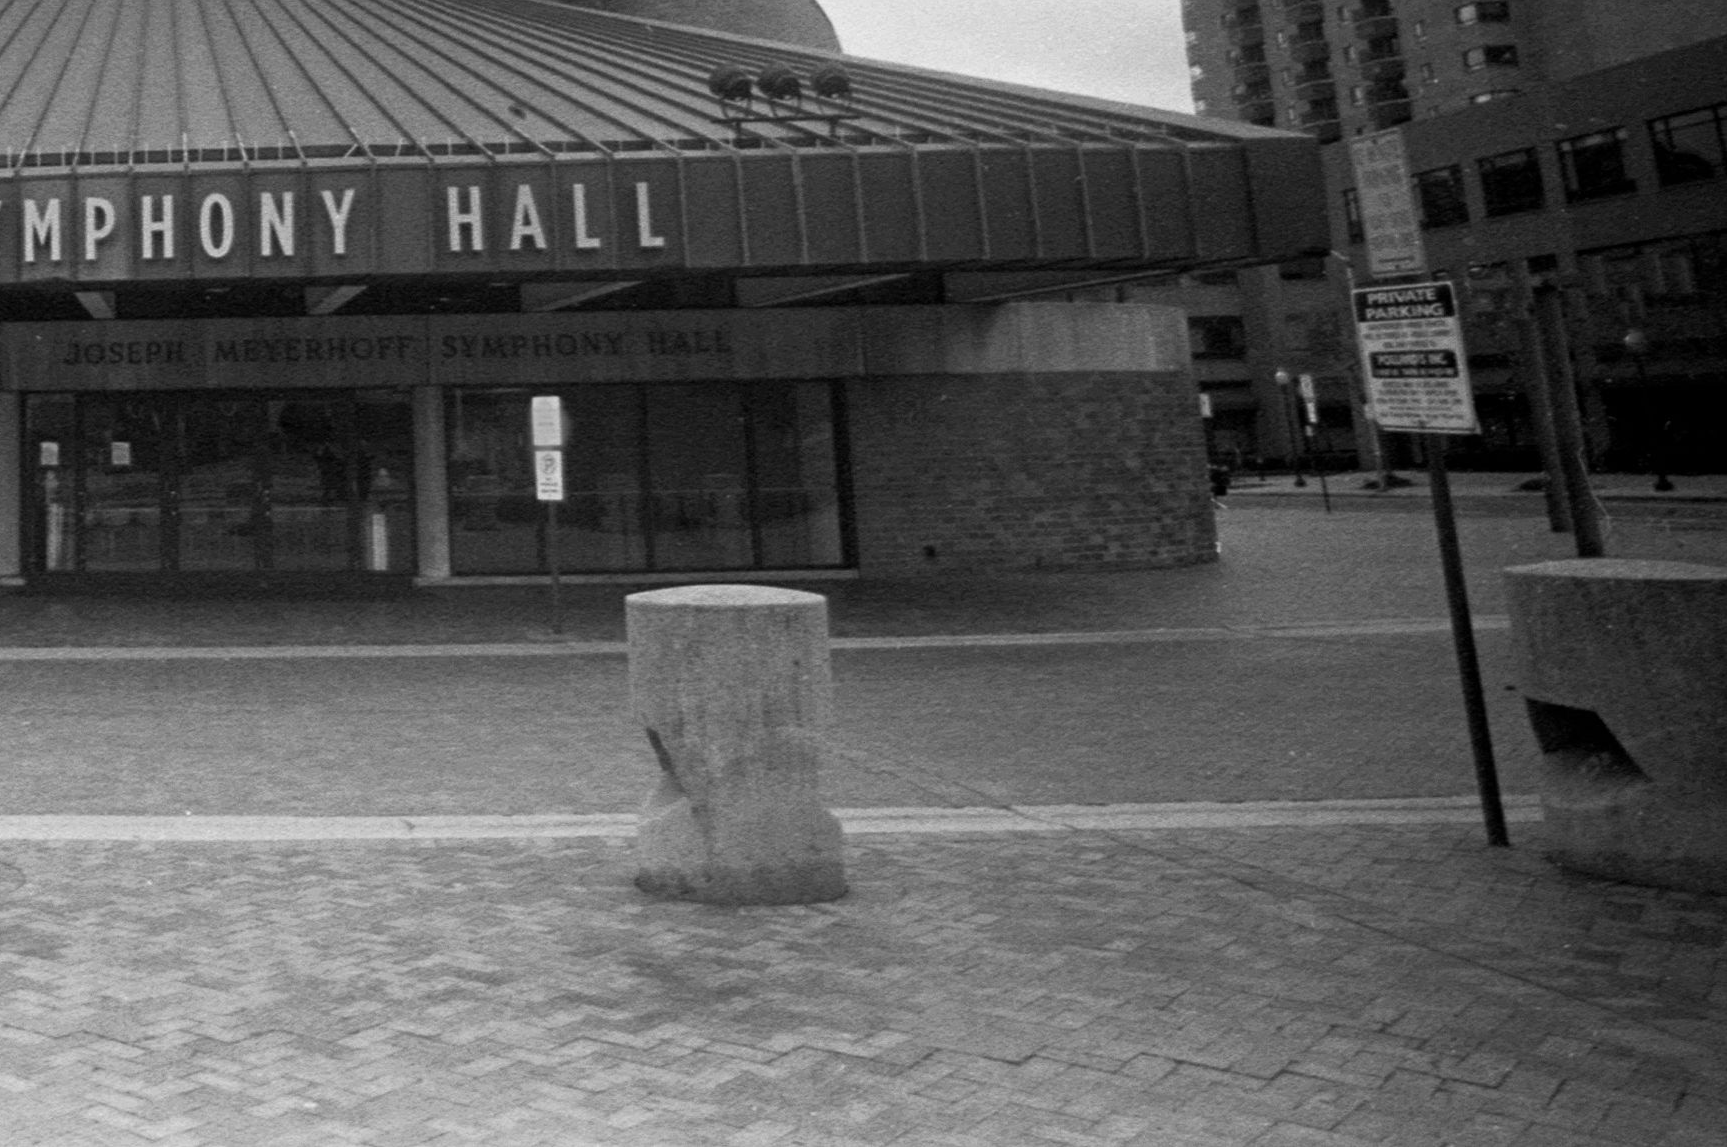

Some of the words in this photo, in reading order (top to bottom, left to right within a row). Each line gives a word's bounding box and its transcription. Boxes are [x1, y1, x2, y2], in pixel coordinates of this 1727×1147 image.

[446, 181, 666, 252] HALL
[1366, 288, 1437, 304] PRIVATE
[1364, 303, 1445, 320] PARKING
[62, 340, 185, 365] JOSEPH
[212, 335, 415, 364] MEYERHOFF
[440, 332, 624, 359] SYMPHONY
[647, 329, 733, 355] HALL
